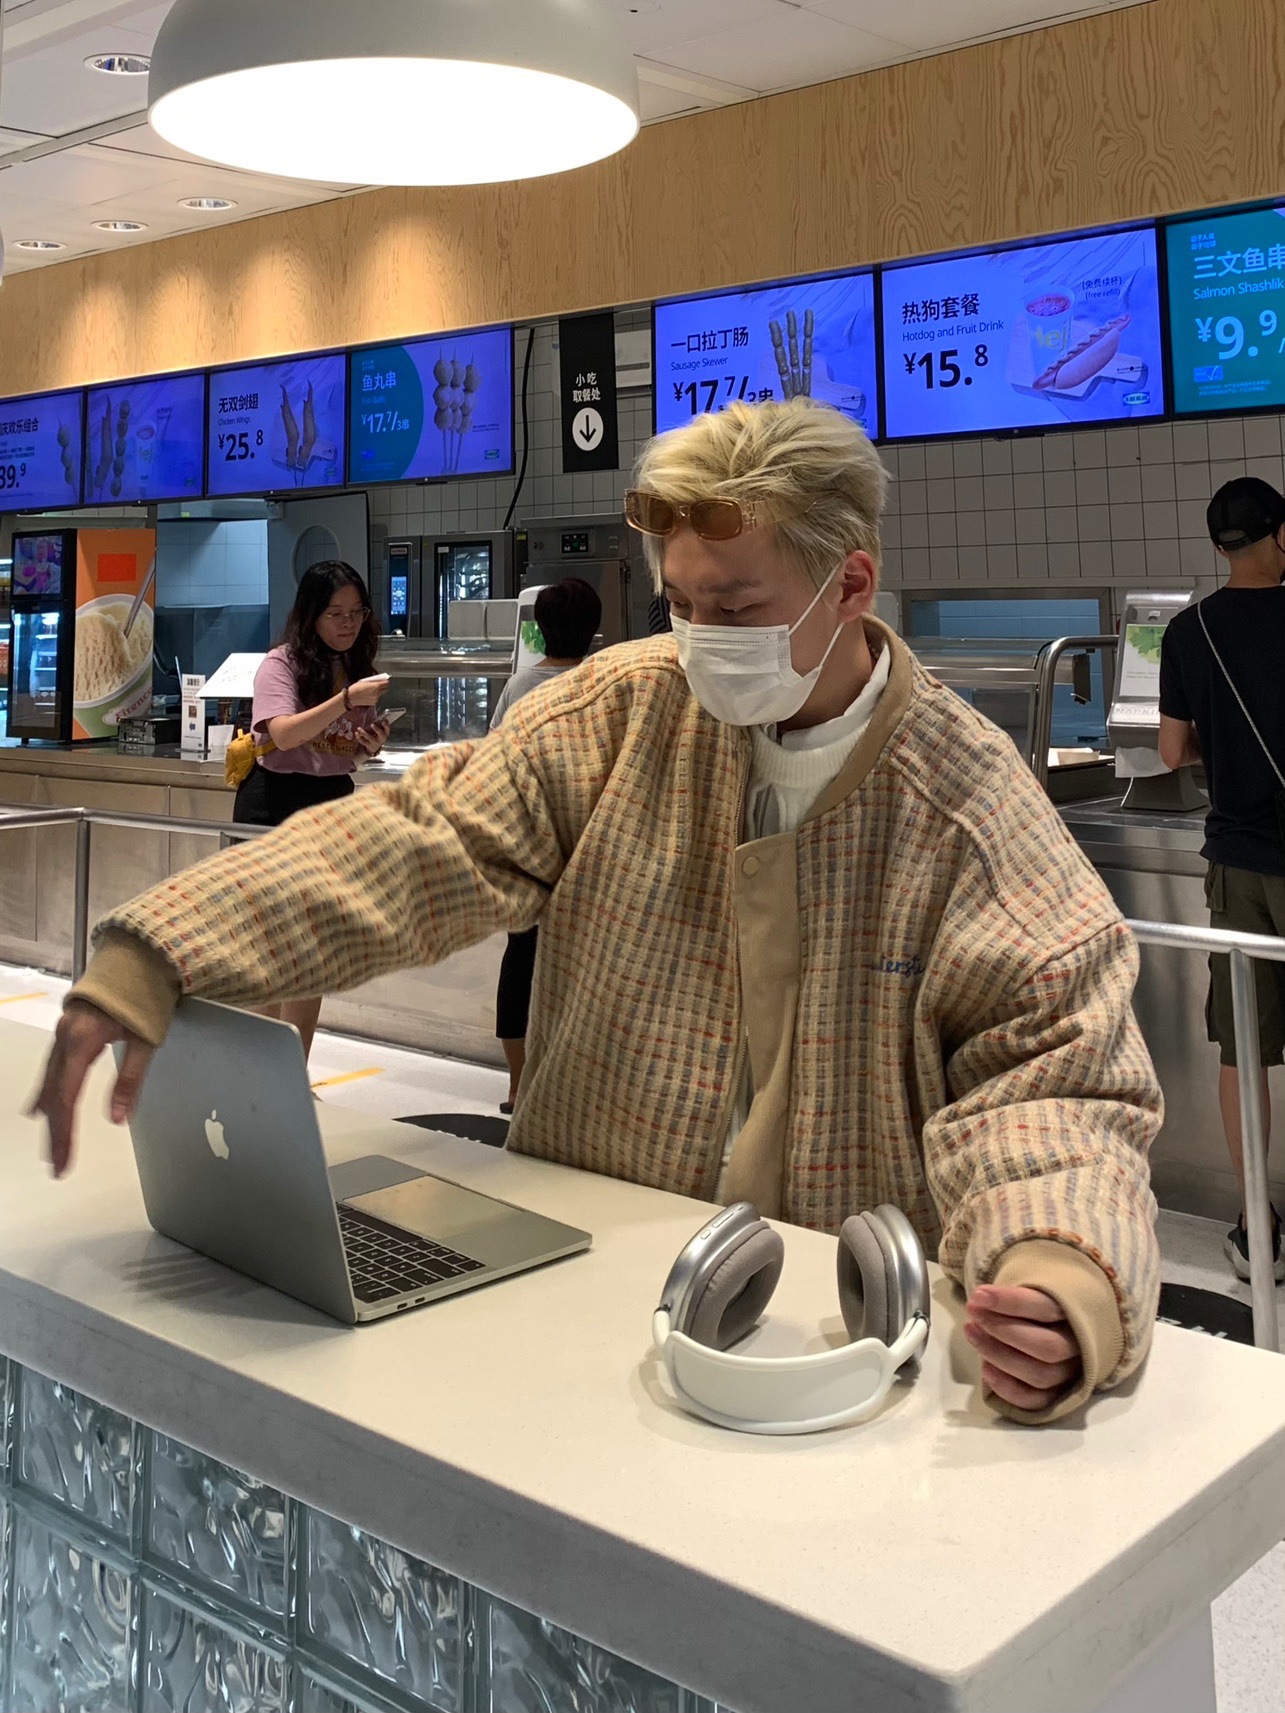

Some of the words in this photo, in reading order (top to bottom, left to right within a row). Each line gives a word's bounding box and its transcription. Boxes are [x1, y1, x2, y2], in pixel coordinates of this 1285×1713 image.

[1194, 243, 1285, 279] 三文鱼串
[1193, 285, 1236, 300] Salmon
[1238, 277, 1284, 295] Shashlik
[902, 293, 980, 325] 热狗套餐
[671, 326, 749, 353] 一口拉丁肠
[902, 330, 935, 342] Hotdog
[937, 326, 954, 338] and
[956, 322, 977, 336] Fruit
[979, 319, 1004, 333] Drink
[671, 359, 701, 371] Sausage
[701, 356, 728, 368] Skewer
[362, 370, 397, 392] 鱼丸串
[575, 372, 598, 387] 小吃
[218, 393, 259, 414] 无双剑翅
[572, 387, 602, 403] 取餐处
[0, 417, 39, 435] 庆欢乐组合
[218, 418, 236, 427] Chicken
[236, 416, 251, 425] Wings
